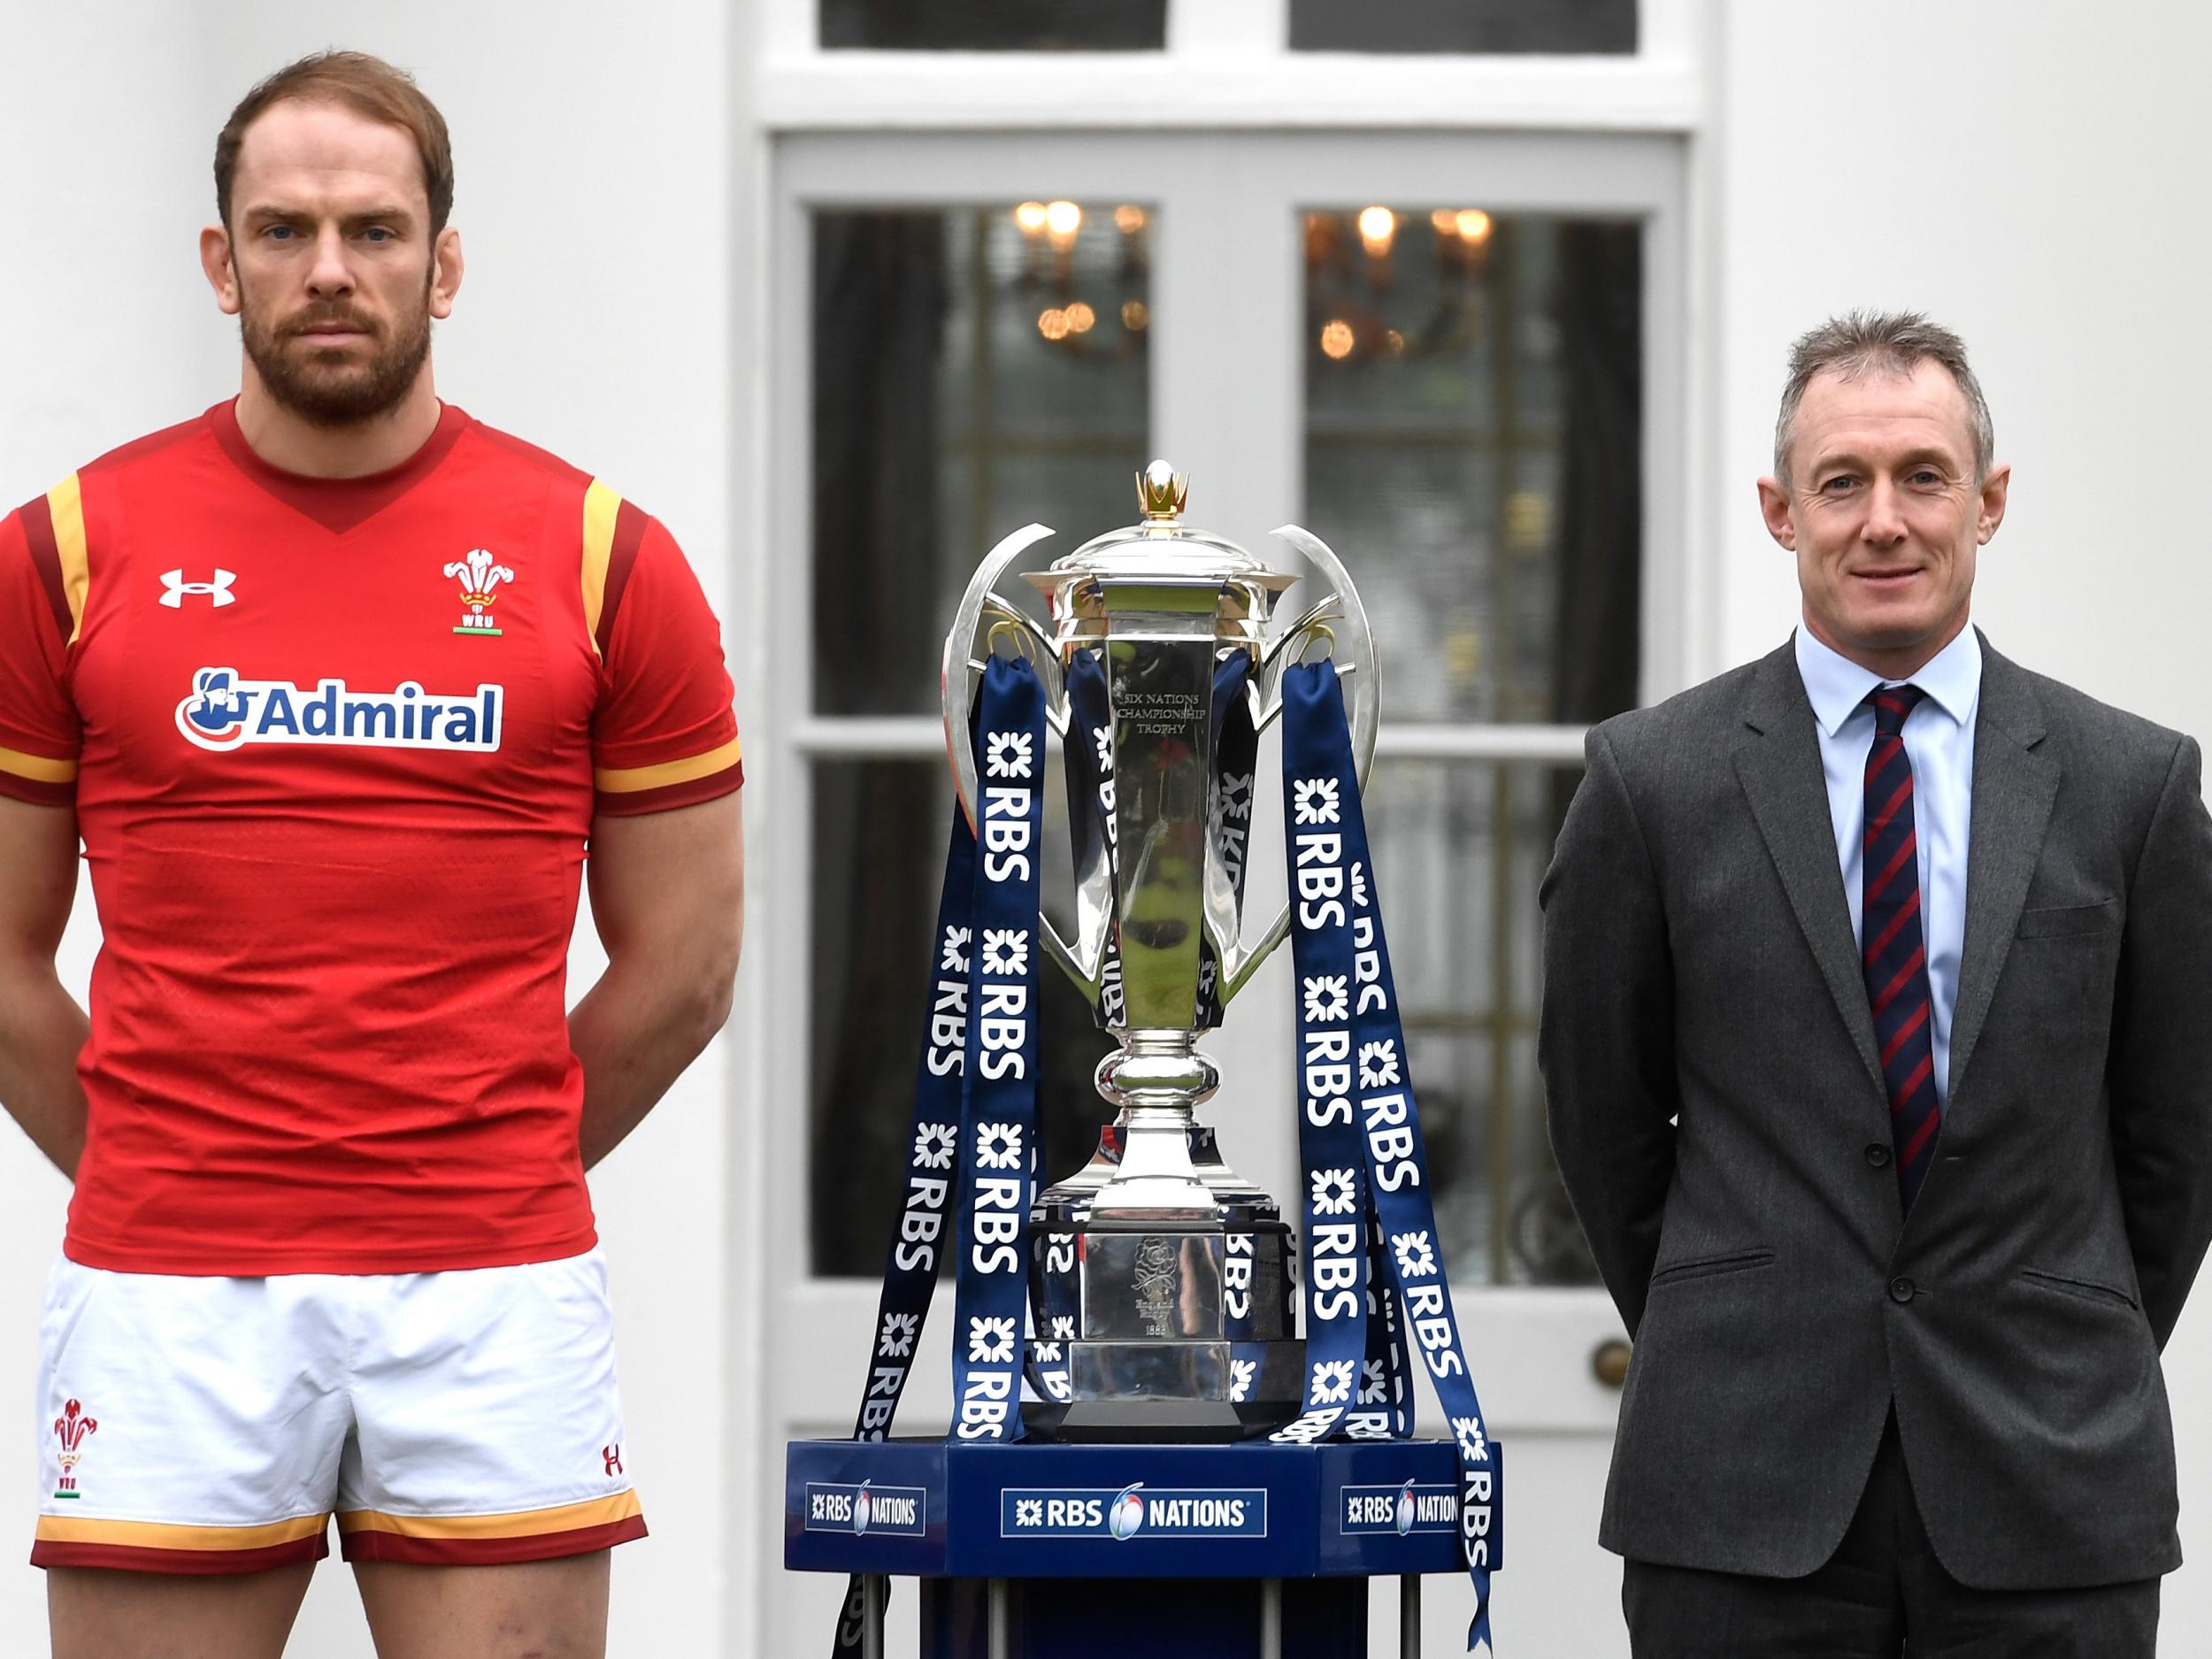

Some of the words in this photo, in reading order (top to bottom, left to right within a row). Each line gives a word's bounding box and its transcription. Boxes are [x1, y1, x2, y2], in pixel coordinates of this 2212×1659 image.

[462, 614, 494, 627] WRU
[256, 685, 495, 743] Admiral
[1117, 708, 1206, 719] CHAMPIONSHIP
[1124, 694, 1143, 704] SIX
[1147, 694, 1199, 704] NATIONS
[1136, 724, 1186, 734] TROPHY
[984, 787, 1031, 882] RBS
[1296, 833, 1345, 930] RBS
[979, 984, 1026, 1079] RBS
[1305, 1030, 1353, 1127] RBS
[1361, 1094, 1420, 1193] RBS
[895, 1177, 948, 1272] RBS
[972, 1178, 1021, 1273] RBS
[1313, 1224, 1358, 1320] RBS
[1407, 1284, 1463, 1379] RBS
[957, 1371, 1011, 1439] RBS
[1269, 1407, 1344, 1443] RBS
[1345, 1412, 1395, 1440] RB
[826, 1494, 851, 1522] RBS
[872, 1497, 916, 1525] NATIONS
[1048, 1500, 1102, 1527] RBS
[1149, 1500, 1244, 1527] NATIONS
[1364, 1495, 1394, 1524] RBS
[1417, 1495, 1459, 1523] NATION
[1463, 1471, 1492, 1568] RBS
